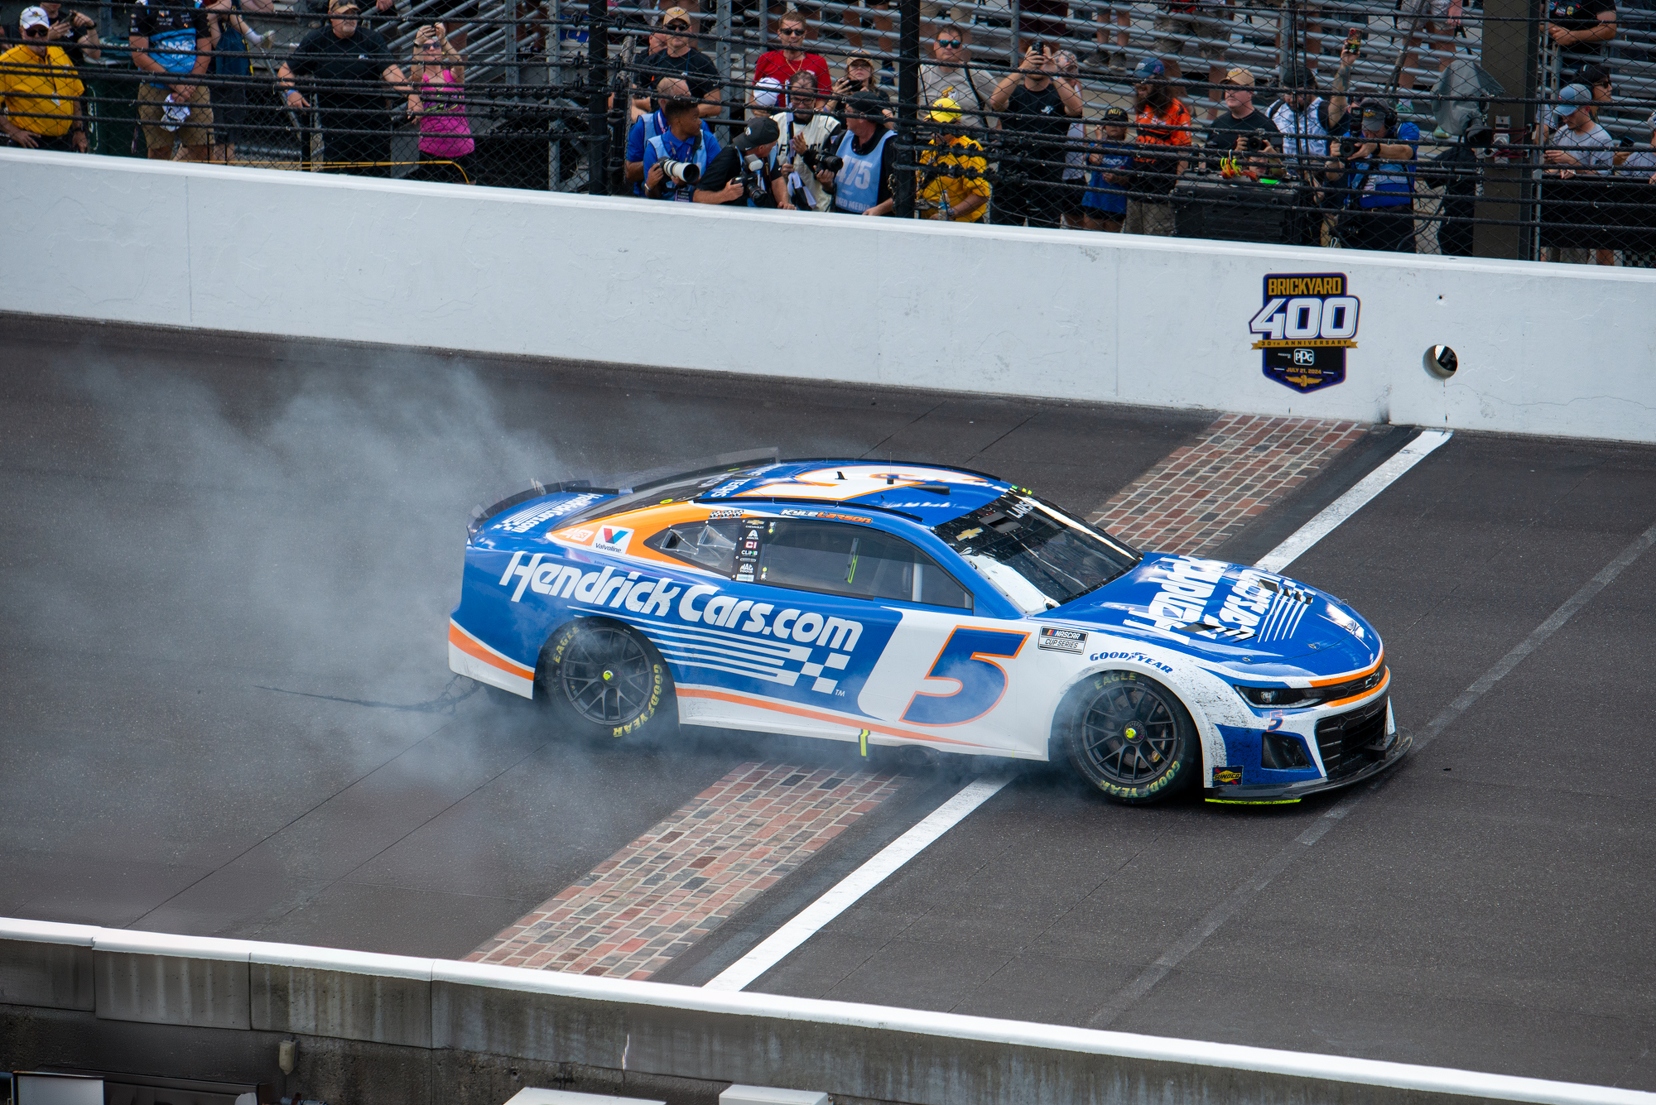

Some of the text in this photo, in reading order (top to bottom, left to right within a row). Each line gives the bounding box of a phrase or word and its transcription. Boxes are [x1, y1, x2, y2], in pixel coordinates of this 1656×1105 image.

[1268, 277, 1341, 296] BRICKYARD
[1250, 297, 1359, 340] 400
[1295, 350, 1313, 363] PPG
[1006, 499, 1036, 519] LARS
[595, 543, 622, 554] Valvoline
[1044, 638, 1079, 648] CUP SERIES
[1054, 630, 1081, 640] NASCAR
[553, 626, 581, 664] EAGLE
[1090, 651, 1173, 674] GOODYEAR
[898, 624, 1032, 727] 5
[1093, 671, 1138, 690] EAGLE
[612, 663, 663, 738] GOODYEAR
[835, 689, 845, 697] TM
[1266, 710, 1284, 732] 5
[1213, 772, 1242, 781] SUNOCO
